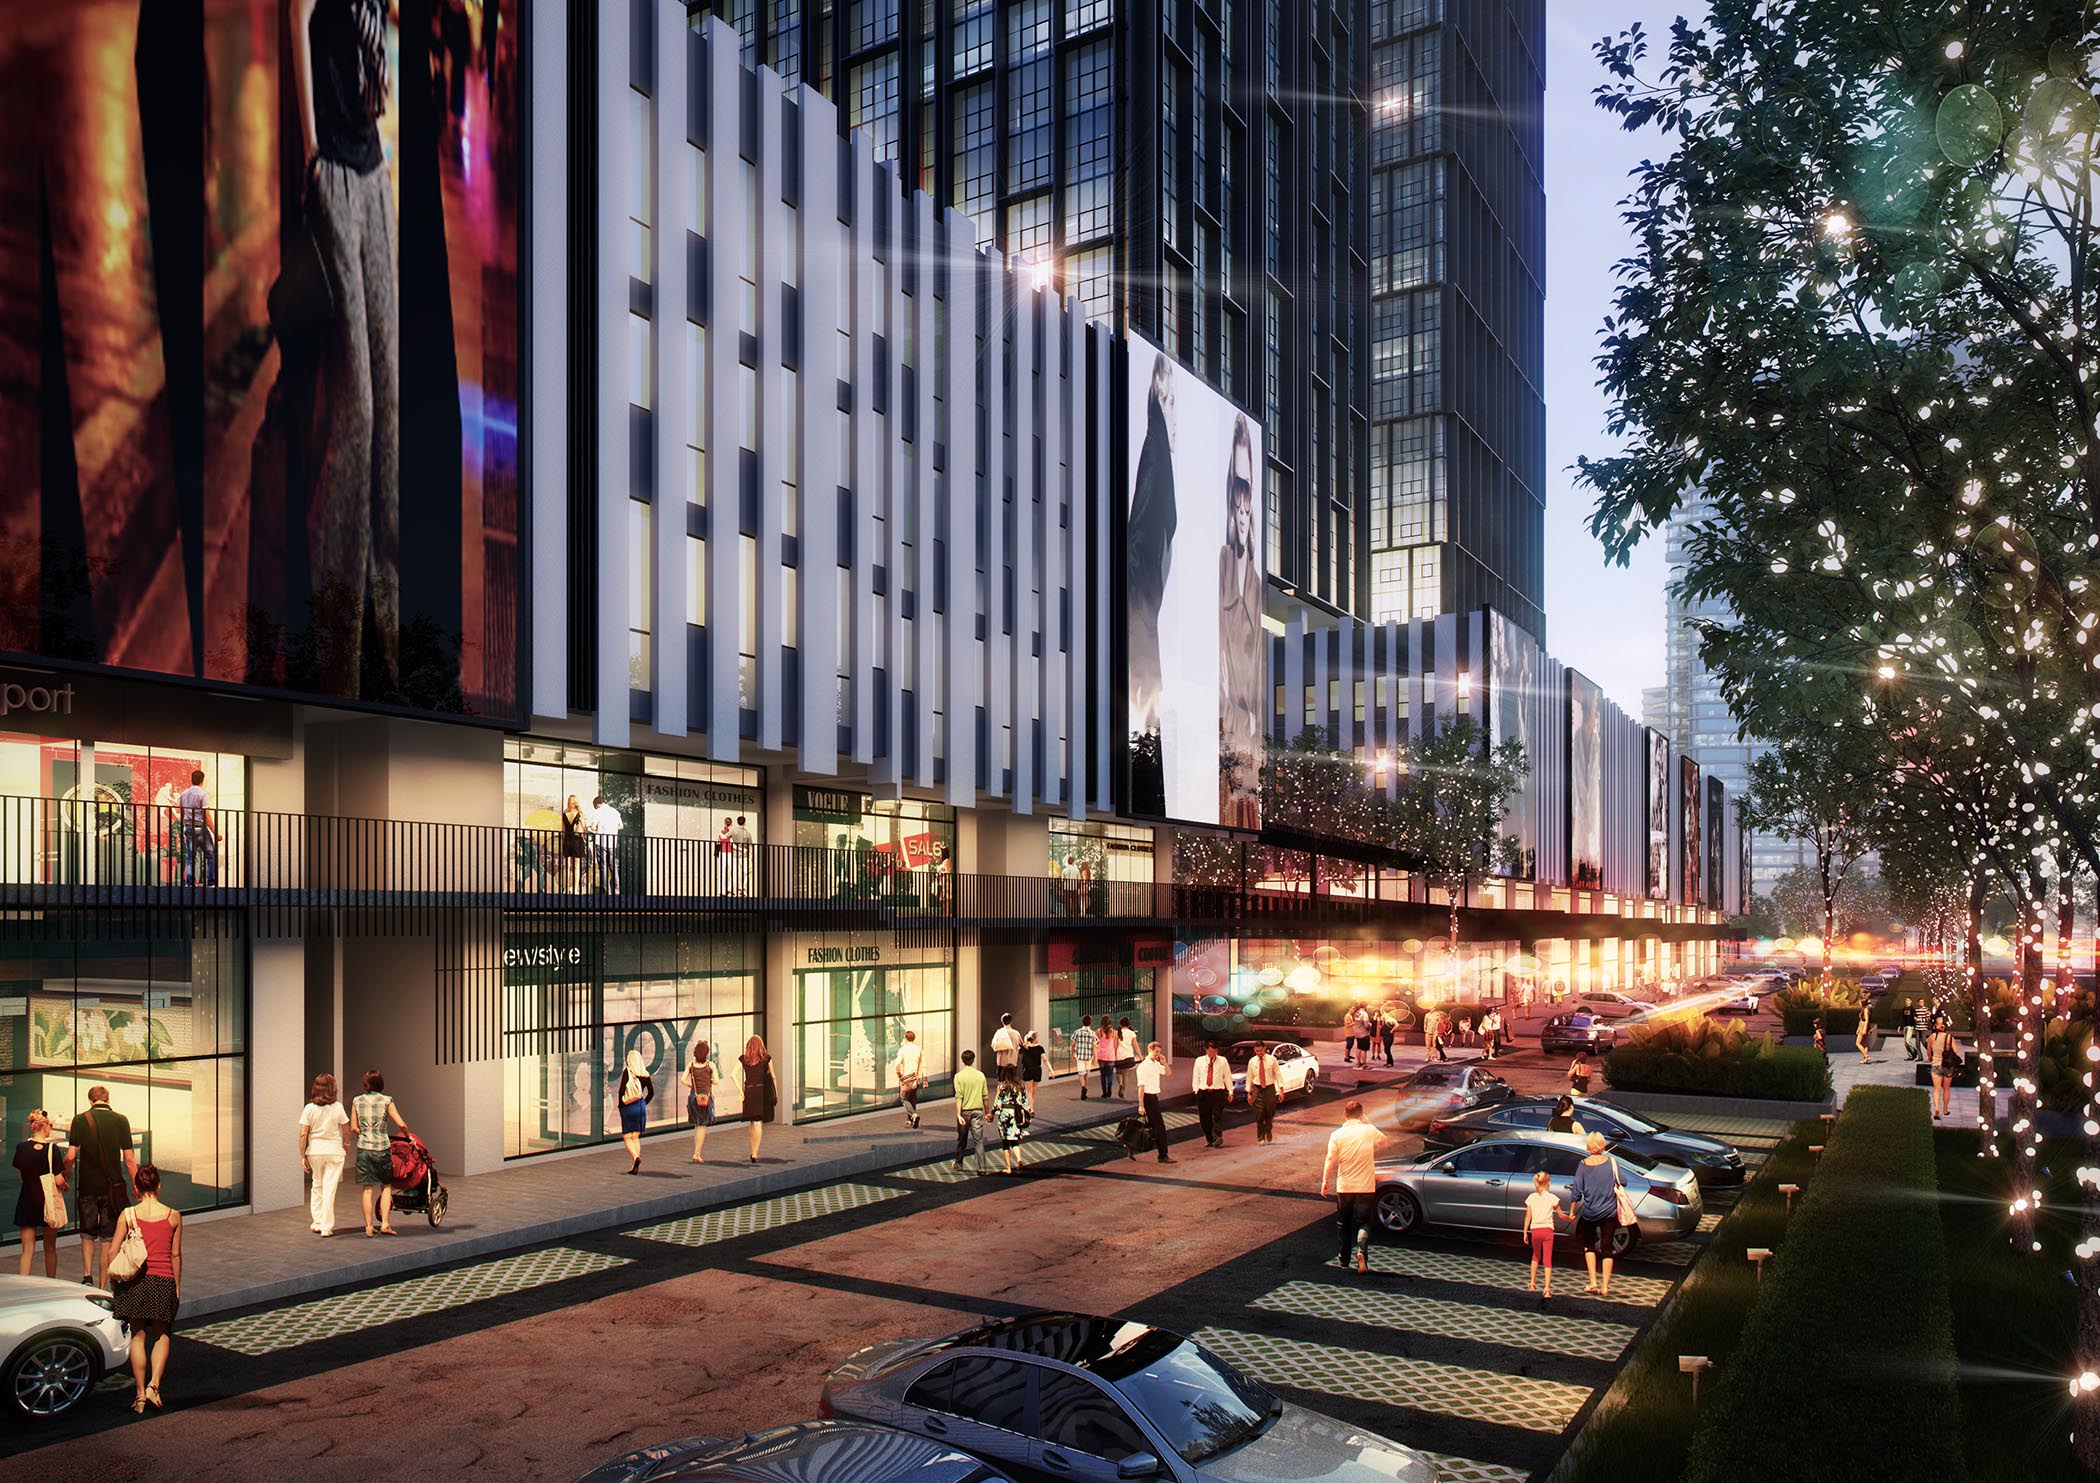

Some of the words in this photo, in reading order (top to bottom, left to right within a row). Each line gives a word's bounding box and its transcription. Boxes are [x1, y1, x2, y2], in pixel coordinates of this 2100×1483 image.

[647, 784, 700, 800] FASHION
[703, 790, 754, 804] CLOTHES
[807, 791, 848, 816] VOGUE
[808, 947, 843, 963] FASHION
[845, 946, 880, 961] CLOTHES
[607, 1018, 701, 1081] JOY
